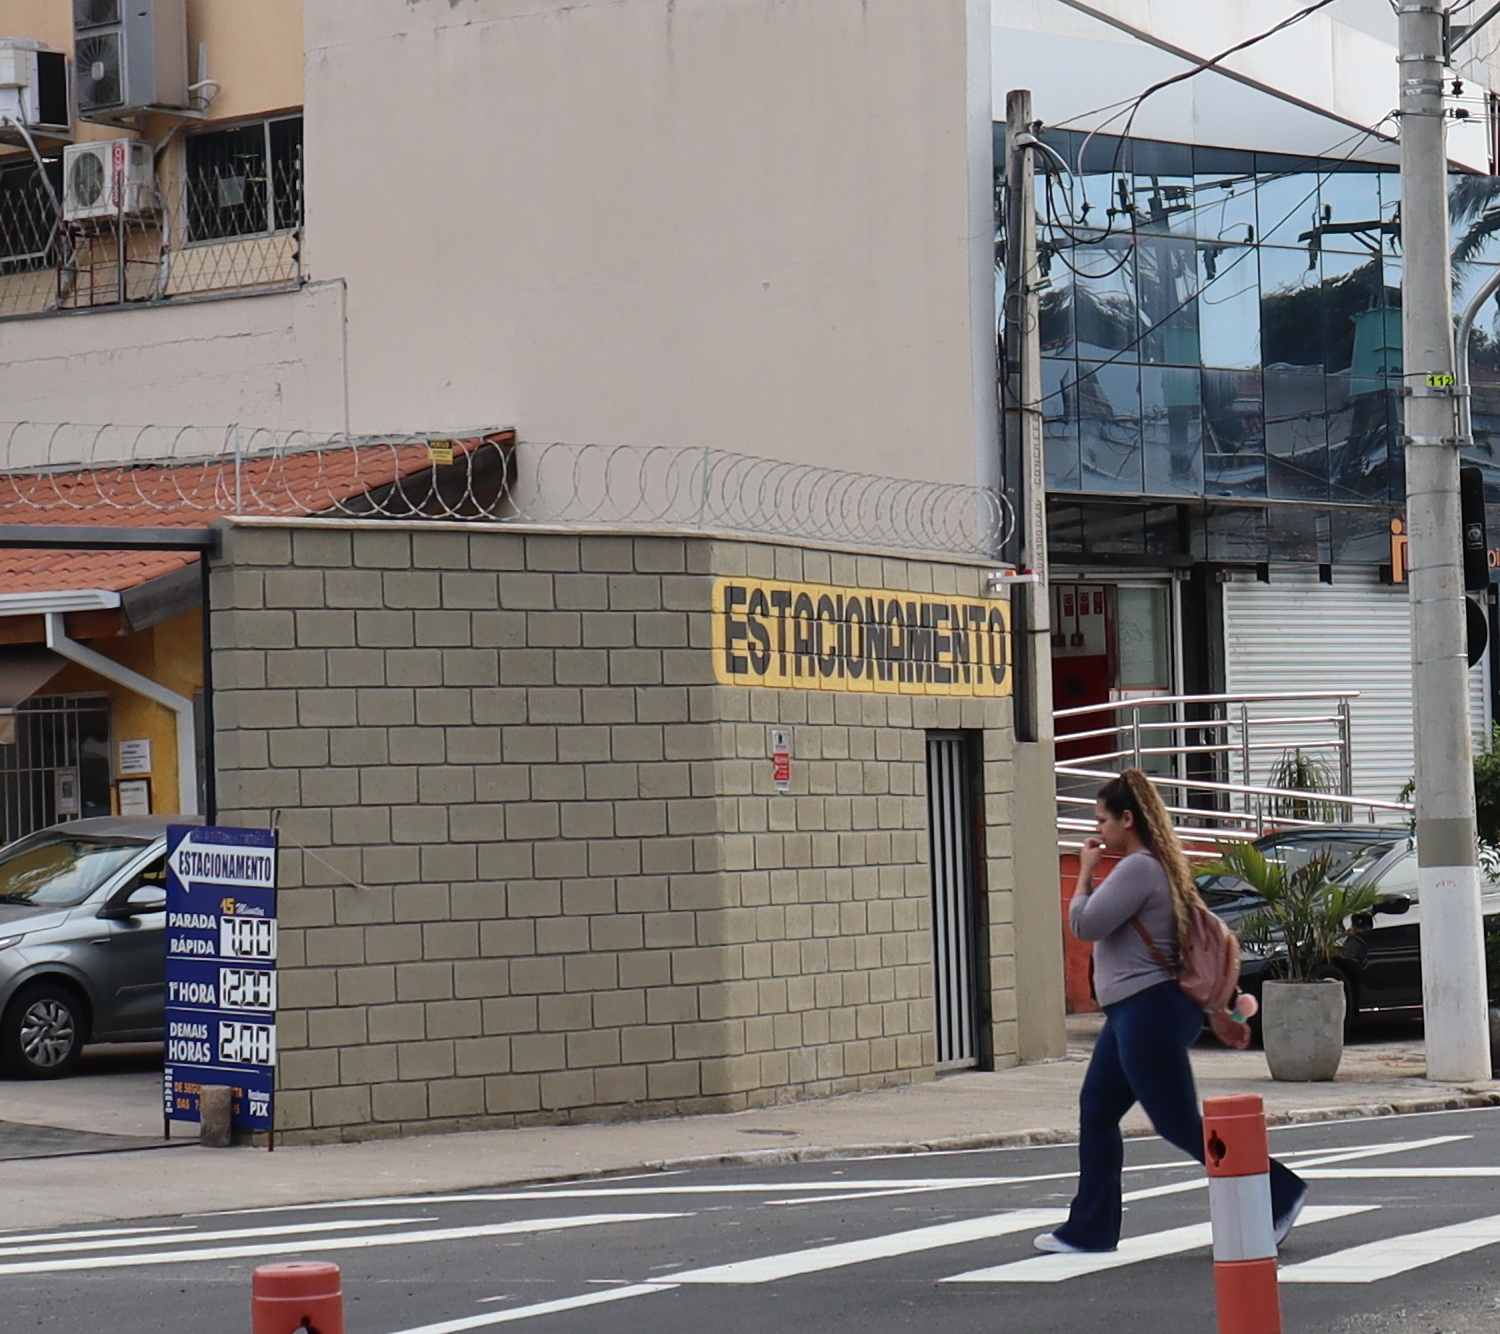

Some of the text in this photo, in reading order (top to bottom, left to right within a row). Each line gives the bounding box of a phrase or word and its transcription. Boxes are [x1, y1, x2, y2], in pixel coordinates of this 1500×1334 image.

[723, 585, 1007, 685] ESTACIONAMENTO
[179, 850, 272, 883] ESTACIONAMENTO
[220, 897, 235, 915] 15
[169, 912, 218, 930] PARADA
[169, 934, 216, 956] RÁPIDA
[169, 1022, 208, 1039] DEMAIS
[168, 1040, 211, 1063] HORAS
[174, 1082, 183, 1092] DE
[184, 1082, 201, 1095] SEGU
[176, 1099, 190, 1110] DAS
[249, 1101, 269, 1117] PIX
